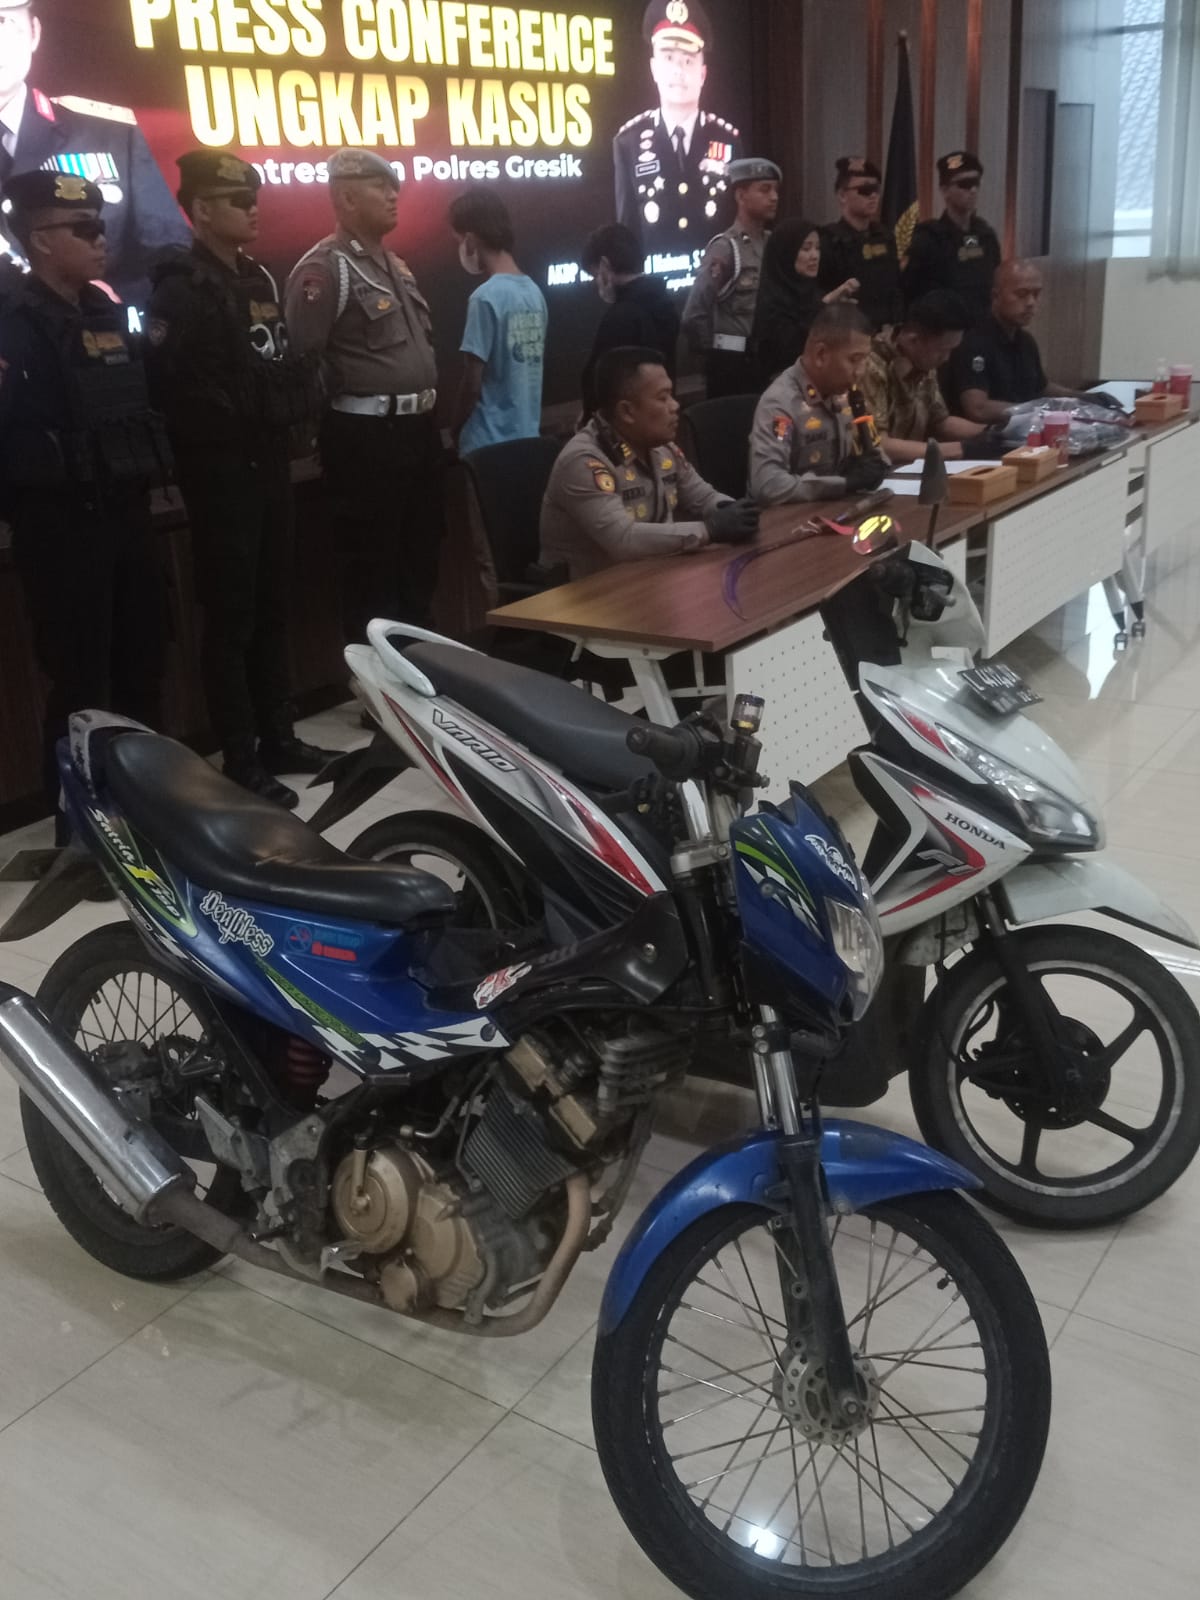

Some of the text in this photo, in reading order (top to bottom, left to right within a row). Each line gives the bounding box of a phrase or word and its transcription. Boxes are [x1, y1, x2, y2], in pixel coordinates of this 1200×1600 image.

[129, 0, 615, 75] PRESS CONFERENCE
[184, 64, 593, 147] UNGKAP KASUS
[413, 154, 499, 181] Polres
[505, 152, 583, 179] Gresik
[432, 708, 520, 773] VARIO
[944, 812, 1006, 850] HONDA
